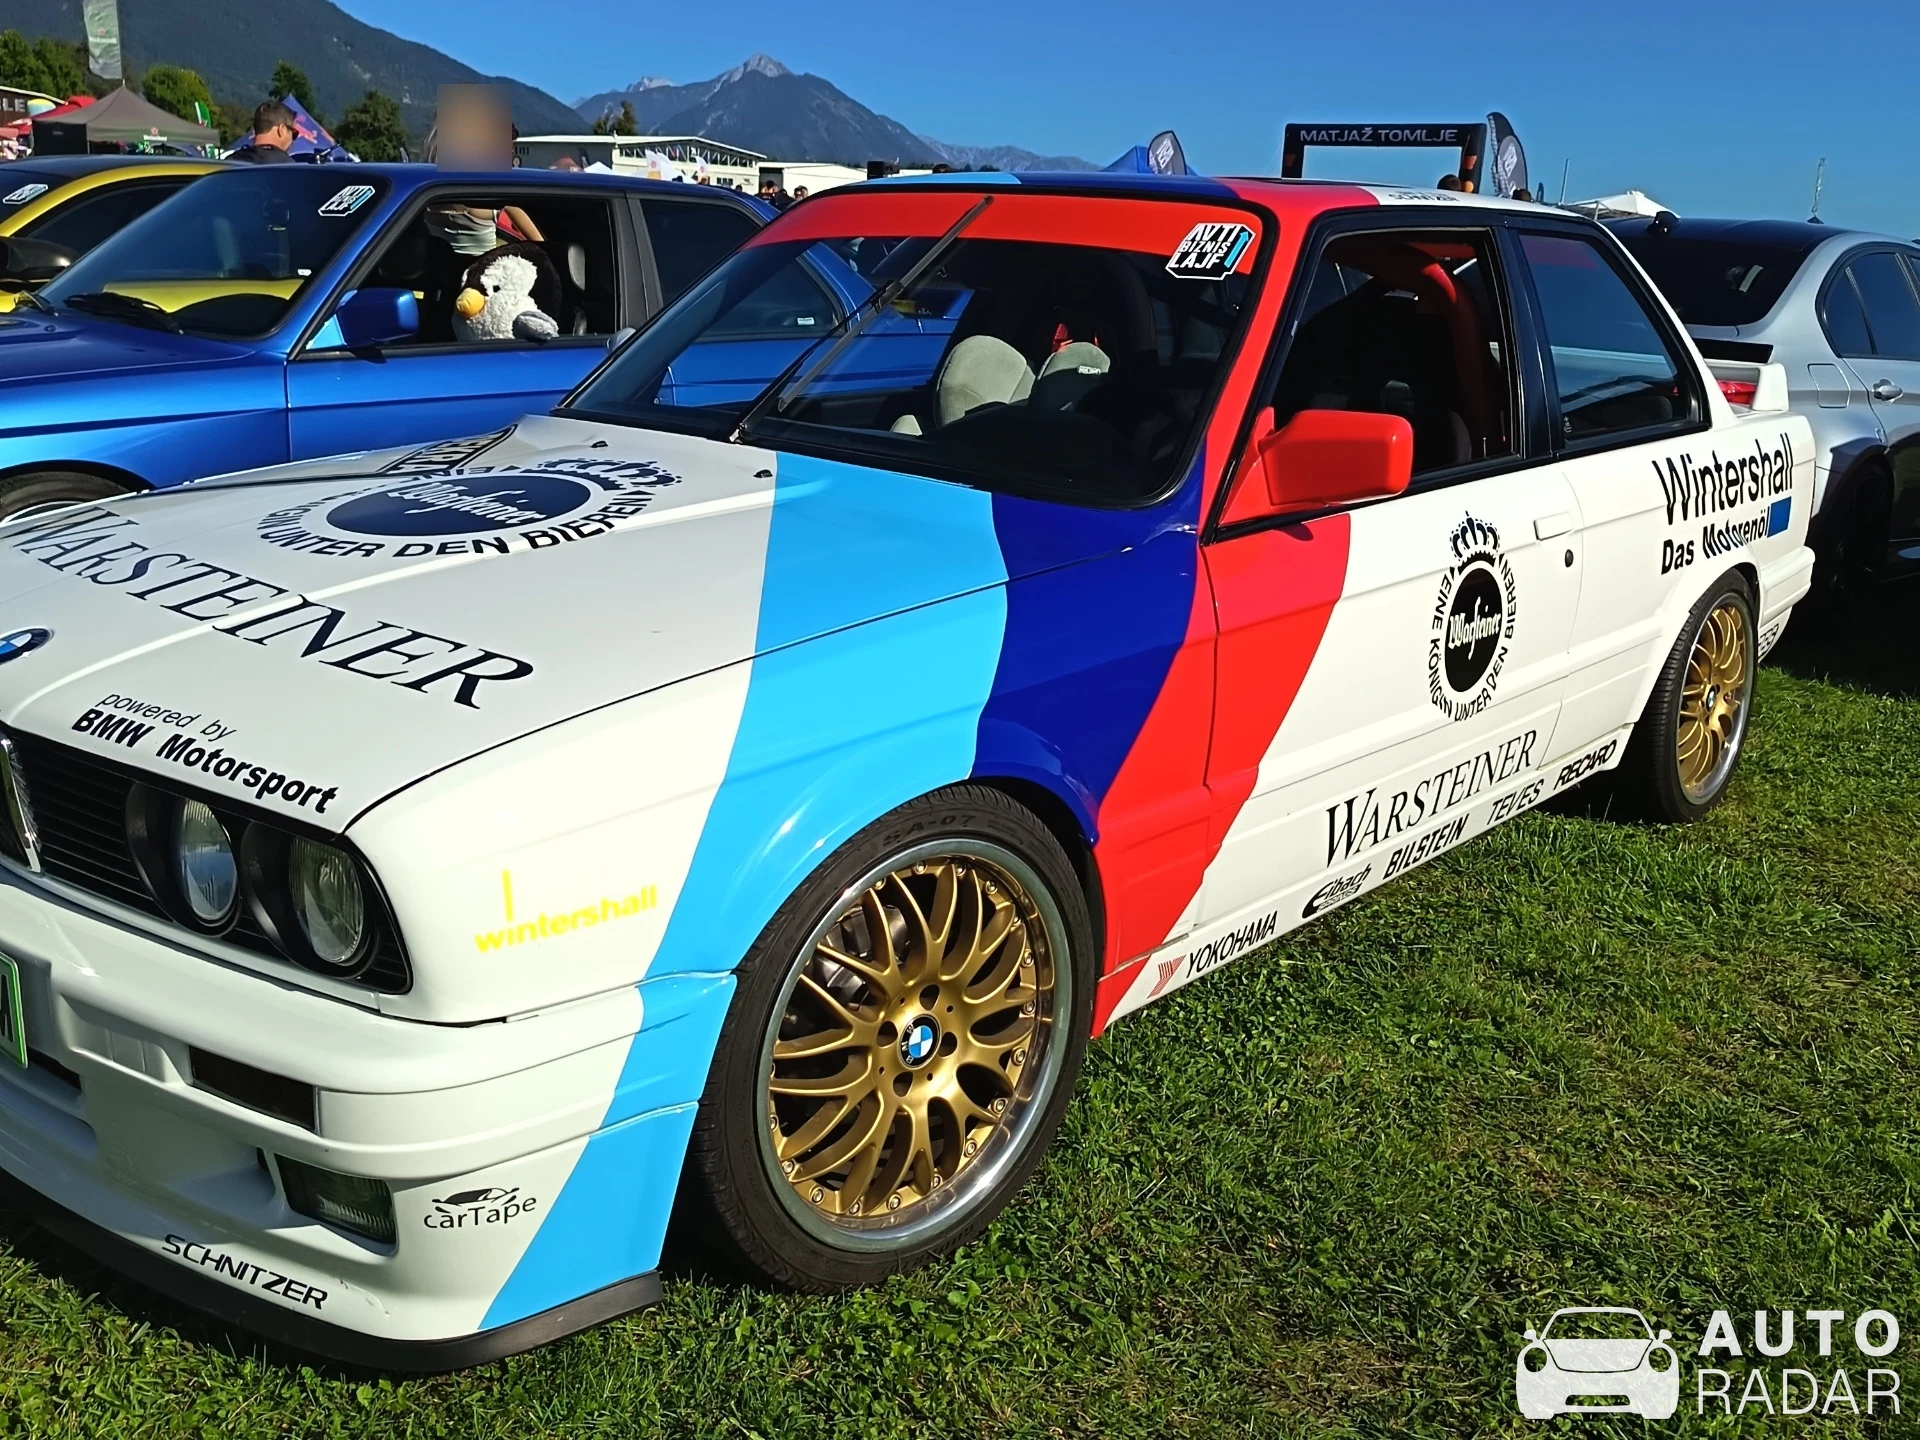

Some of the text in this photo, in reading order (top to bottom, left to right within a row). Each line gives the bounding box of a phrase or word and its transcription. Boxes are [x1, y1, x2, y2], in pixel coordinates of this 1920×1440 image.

[0, 97, 26, 112] LE
[1300, 126, 1458, 142] MATJAŽ TOMLJE
[1168, 252, 1225, 269] LAJF
[1179, 240, 1231, 254] BIZNIS
[1186, 224, 1242, 242] AVTI
[1651, 432, 1793, 525] Wintershall
[260, 526, 386, 557] UNTER
[392, 536, 511, 558] DEN
[519, 496, 654, 549] BIEREN
[1661, 505, 1770, 575] Das Motorenöl
[0, 506, 534, 710] WARSTEINER
[1428, 560, 1517, 722] EINE KÖNIGIN UNTER DEN BIEREN
[95, 693, 237, 742] powered by
[71, 708, 339, 814] BMW Motorsport
[1326, 730, 1538, 868] WARSTEINER
[1186, 910, 1278, 978] YOKOHAMA
[1302, 863, 1372, 918] Eibach
[1382, 813, 1470, 880] BILSTEIN
[1487, 778, 1545, 825] TEVES
[1553, 739, 1618, 790] RECARO
[474, 870, 658, 953] wintershall
[424, 1197, 537, 1228] carTape
[161, 1234, 328, 1310] SCHNITZER
